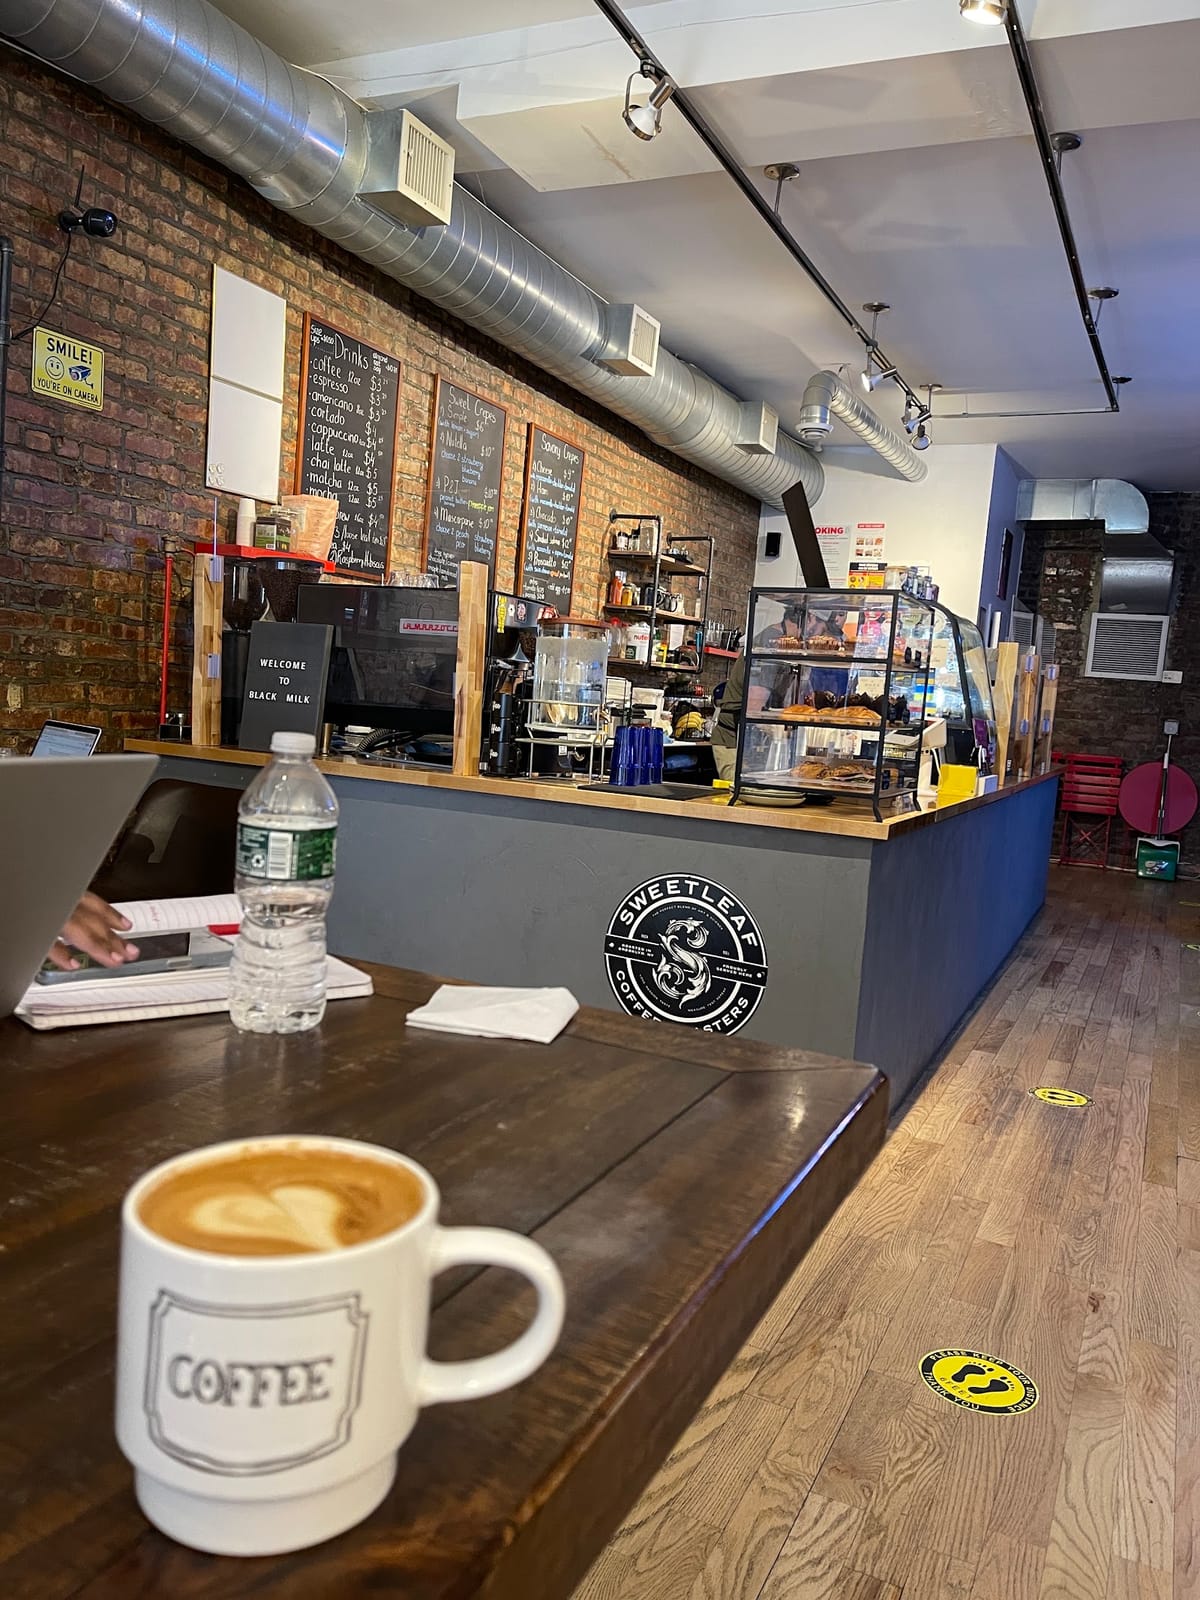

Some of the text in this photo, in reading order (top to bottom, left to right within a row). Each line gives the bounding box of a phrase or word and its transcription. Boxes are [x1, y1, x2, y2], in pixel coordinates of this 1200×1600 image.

[47, 338, 92, 365] SMILE!
[334, 333, 369, 370] Drinks
[313, 355, 342, 379] coffee
[38, 377, 99, 404] YOU'RE ON CAMERA
[313, 373, 349, 394] espresso
[312, 392, 354, 412] americano
[448, 386, 497, 425] Sweet Crepes
[311, 405, 346, 425] cortado
[311, 422, 360, 444] cappuccino
[446, 430, 468, 451] Nutella
[311, 435, 335, 456] latte
[541, 432, 580, 465] Savory Crepes
[310, 452, 330, 470] chai
[334, 457, 351, 475] latte
[310, 471, 342, 489] matcha
[815, 527, 844, 535] OKING
[414, 623, 459, 633] MARZOCC
[634, 633, 651, 641] nute
[260, 658, 307, 670] WELCOME
[279, 676, 290, 685] TO
[249, 690, 311, 704] BLACK MILK
[620, 879, 759, 948] SWEETLEAF
[702, 996, 749, 1033] STERS
[168, 1354, 334, 1408] COFFEE
[924, 1372, 980, 1410] THANK YOU
[929, 1350, 1035, 1413] PLEASE KEEP YOUR DISTANCE
